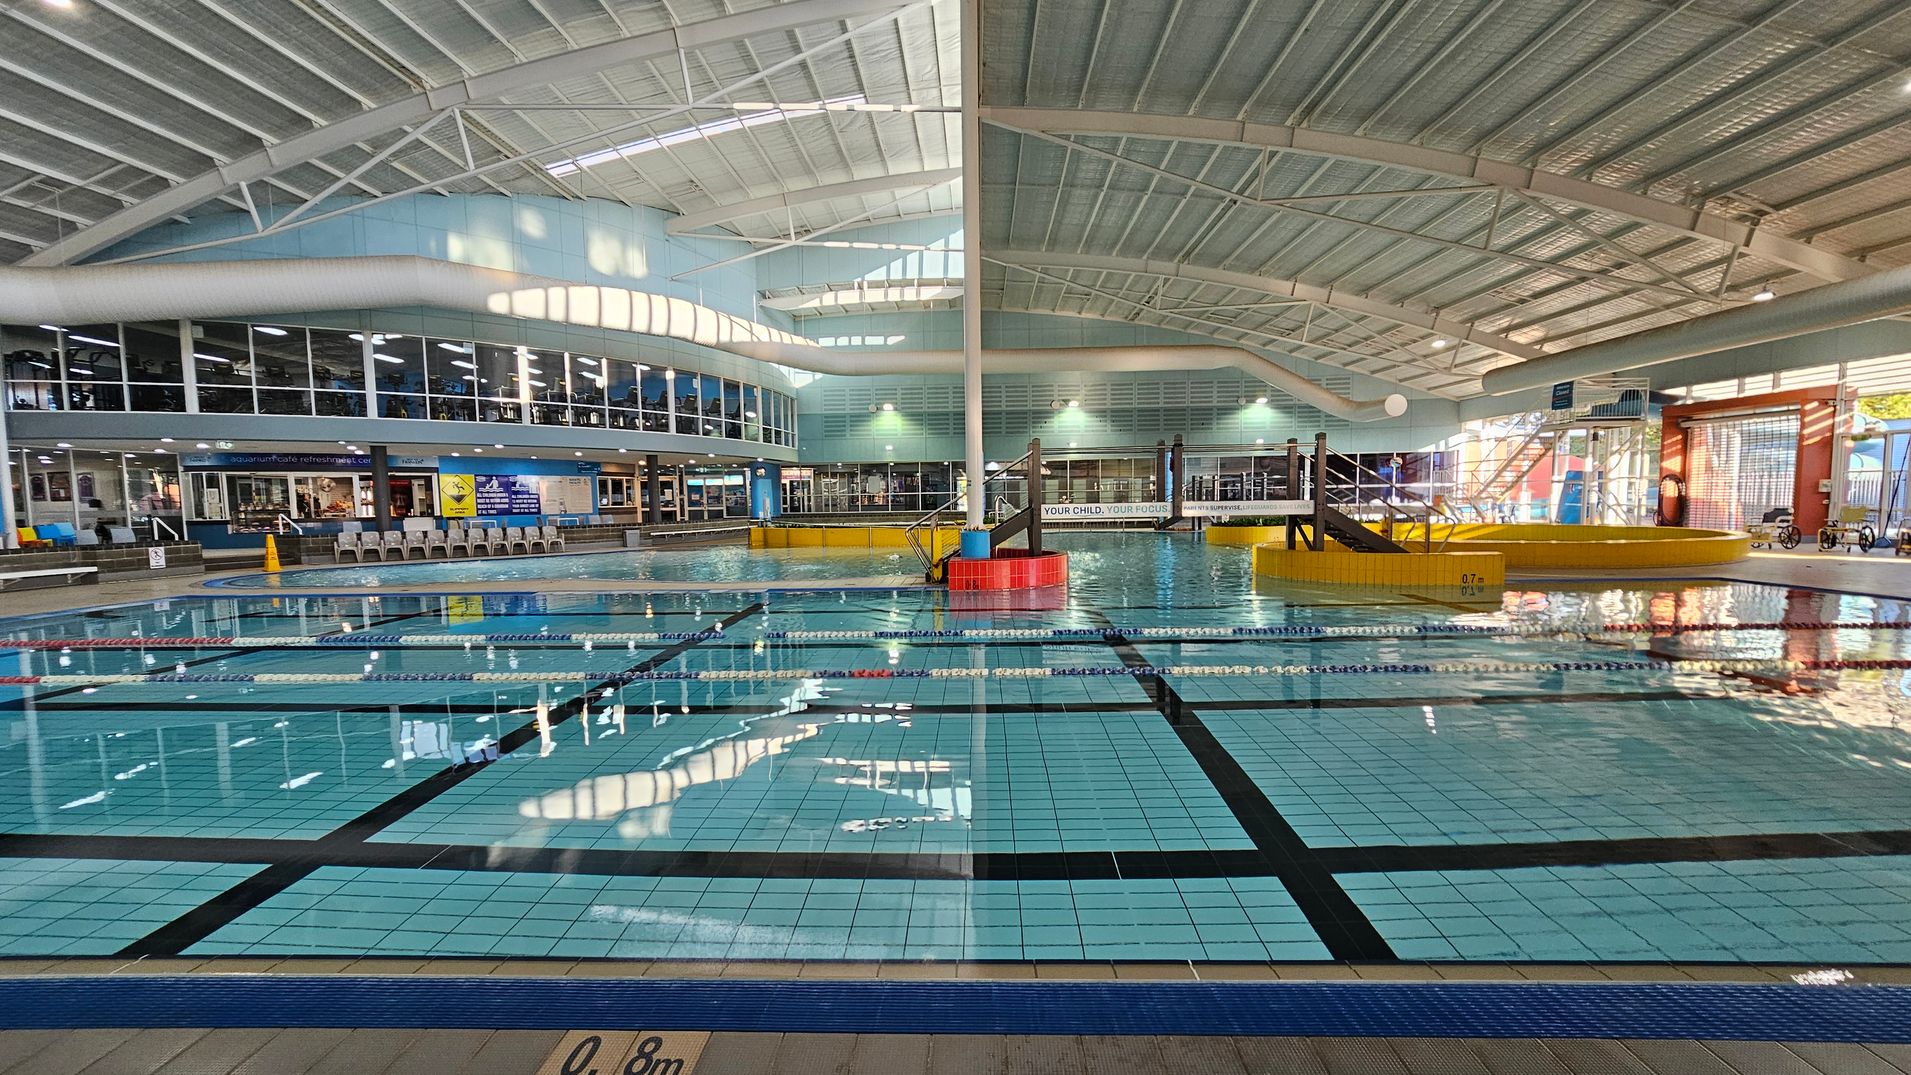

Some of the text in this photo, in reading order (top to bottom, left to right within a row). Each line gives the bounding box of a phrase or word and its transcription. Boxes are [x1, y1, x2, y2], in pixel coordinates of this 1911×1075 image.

[230, 455, 274, 465] aquarium
[278, 455, 298, 463] café
[300, 455, 356, 464] refreshment
[1044, 504, 1170, 515] YOUR CHILD. YOUR FOCUS.
